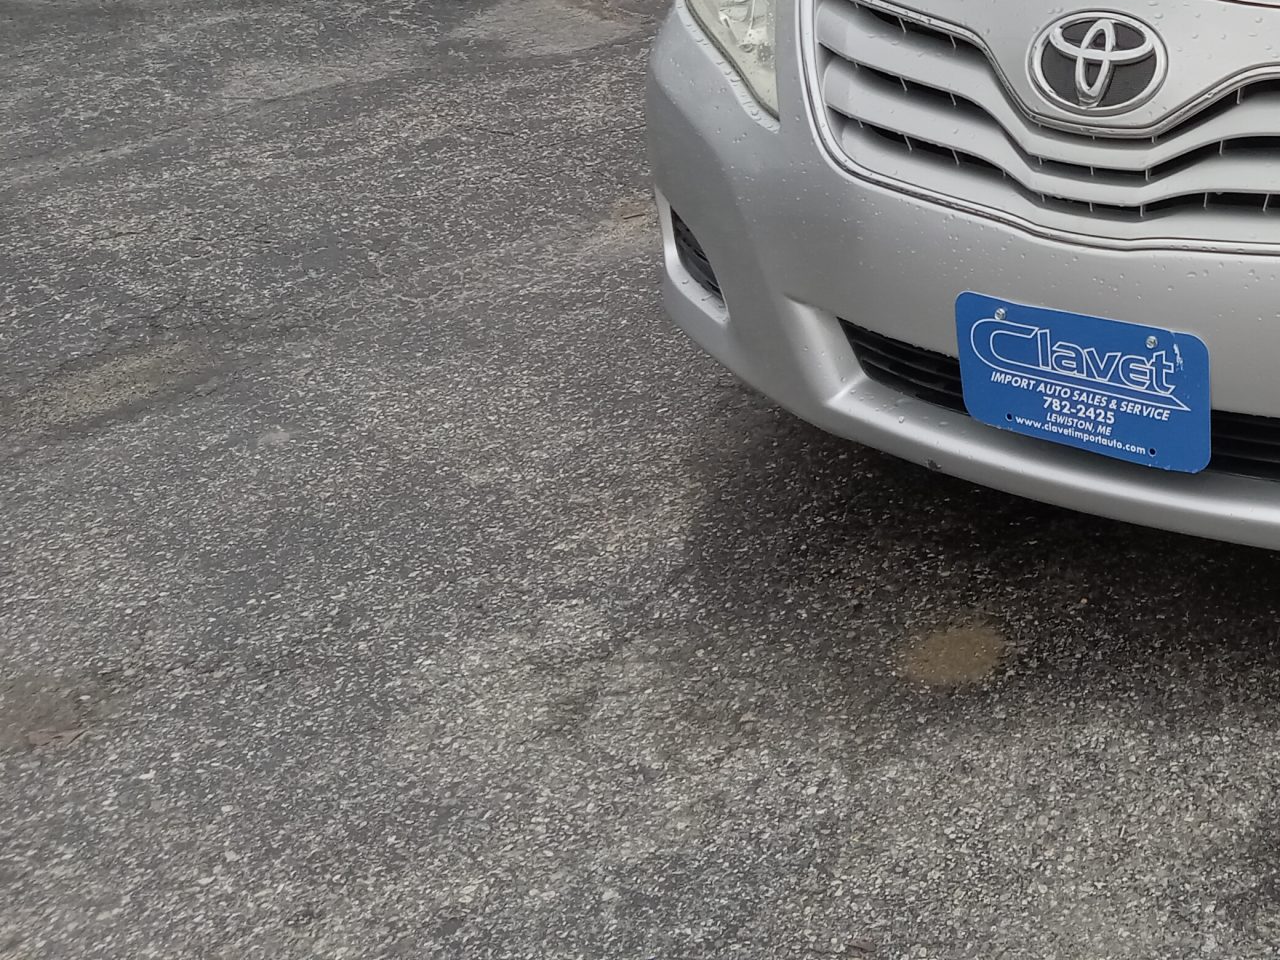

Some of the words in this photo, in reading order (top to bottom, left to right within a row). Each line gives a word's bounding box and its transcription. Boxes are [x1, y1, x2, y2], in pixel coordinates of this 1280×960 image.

[970, 318, 1191, 412] Clavet
[990, 371, 1036, 391] IMPORT
[1037, 383, 1071, 400] AUTO
[1072, 390, 1107, 407] SALES
[1109, 399, 1117, 409] &
[1120, 401, 1171, 421] SERVICE
[1043, 396, 1115, 425] 782-2425
[1015, 416, 1146, 455] www.clavetimportauto.com
[1046, 412, 1097, 434] LEWISTON,
[1097, 425, 1112, 436] ME
